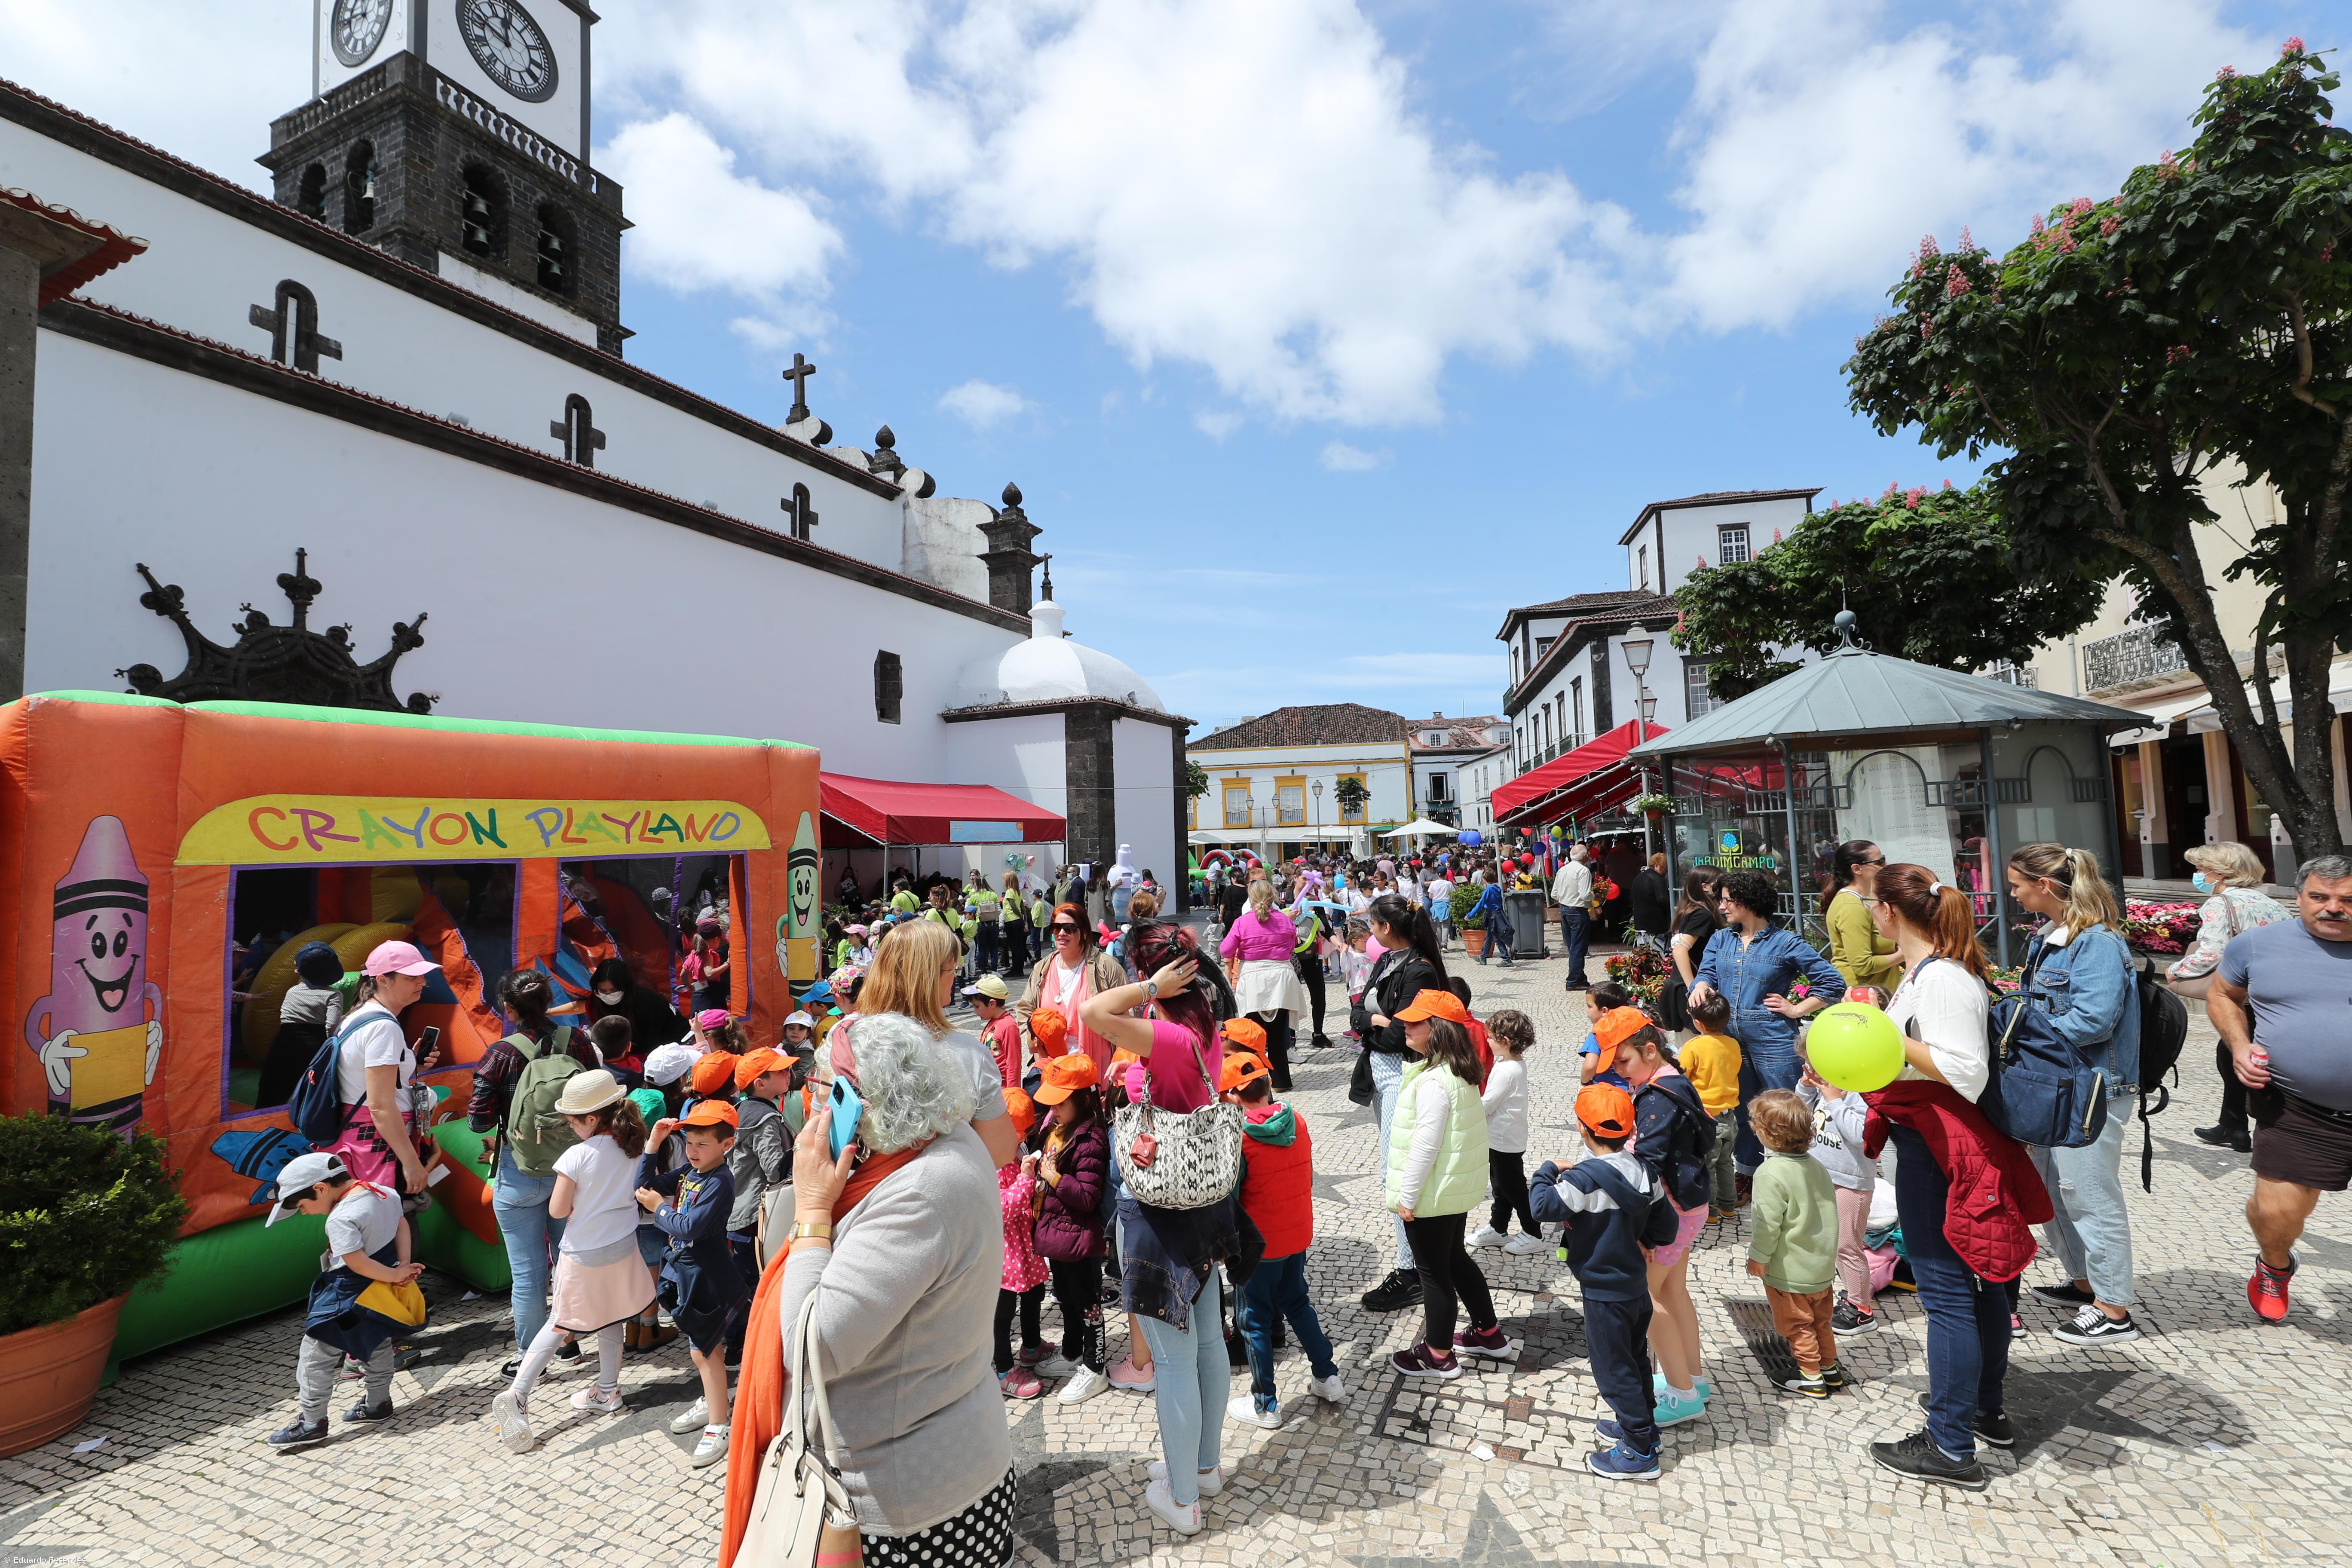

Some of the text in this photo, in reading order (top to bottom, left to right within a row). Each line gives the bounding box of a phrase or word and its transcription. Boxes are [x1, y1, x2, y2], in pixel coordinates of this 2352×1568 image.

[248, 806, 741, 852] CRAYON PLAYLAND
[1692, 856, 1775, 869] JARDIMCAMPO
